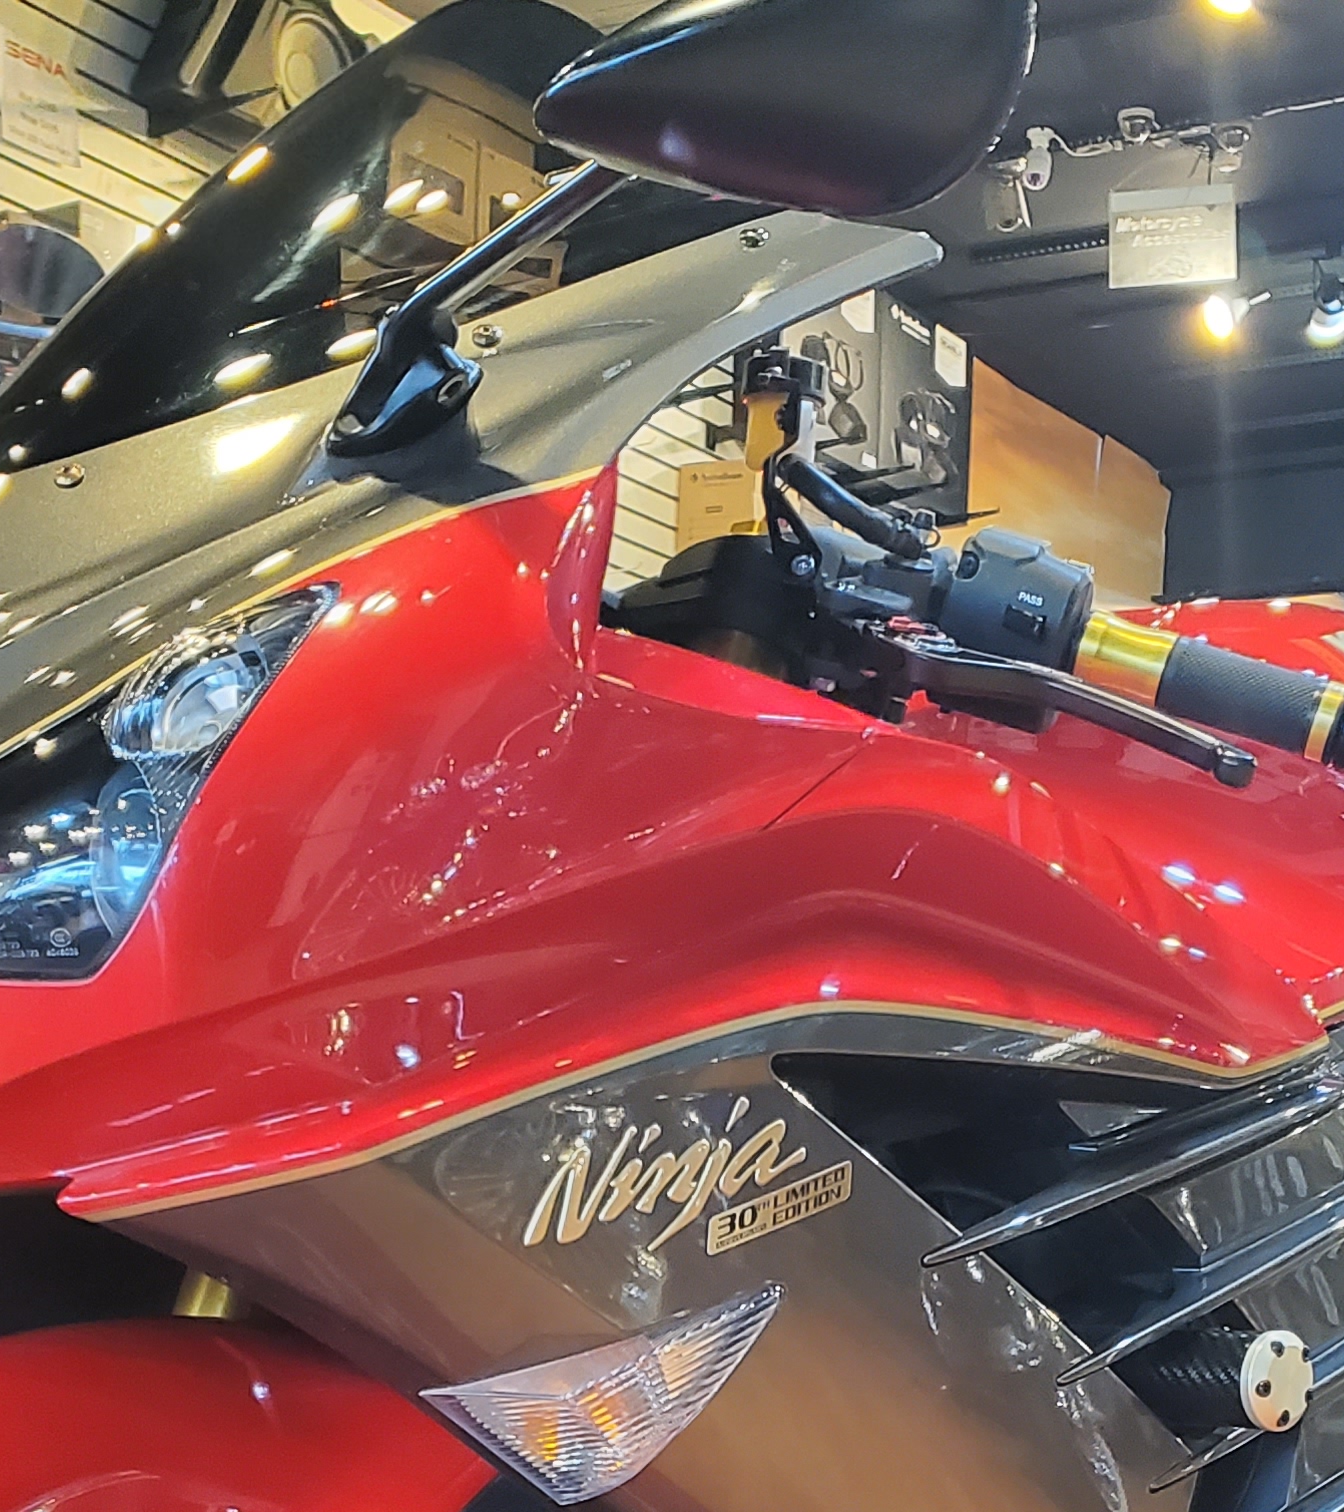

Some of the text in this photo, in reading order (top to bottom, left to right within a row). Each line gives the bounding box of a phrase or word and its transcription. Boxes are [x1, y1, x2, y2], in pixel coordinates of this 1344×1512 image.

[5, 39, 67, 77] SENA
[1017, 591, 1044, 607] PASS
[523, 1095, 807, 1252] Ninja
[773, 1167, 845, 1207] LIMITED
[772, 1184, 842, 1227] EDITION
